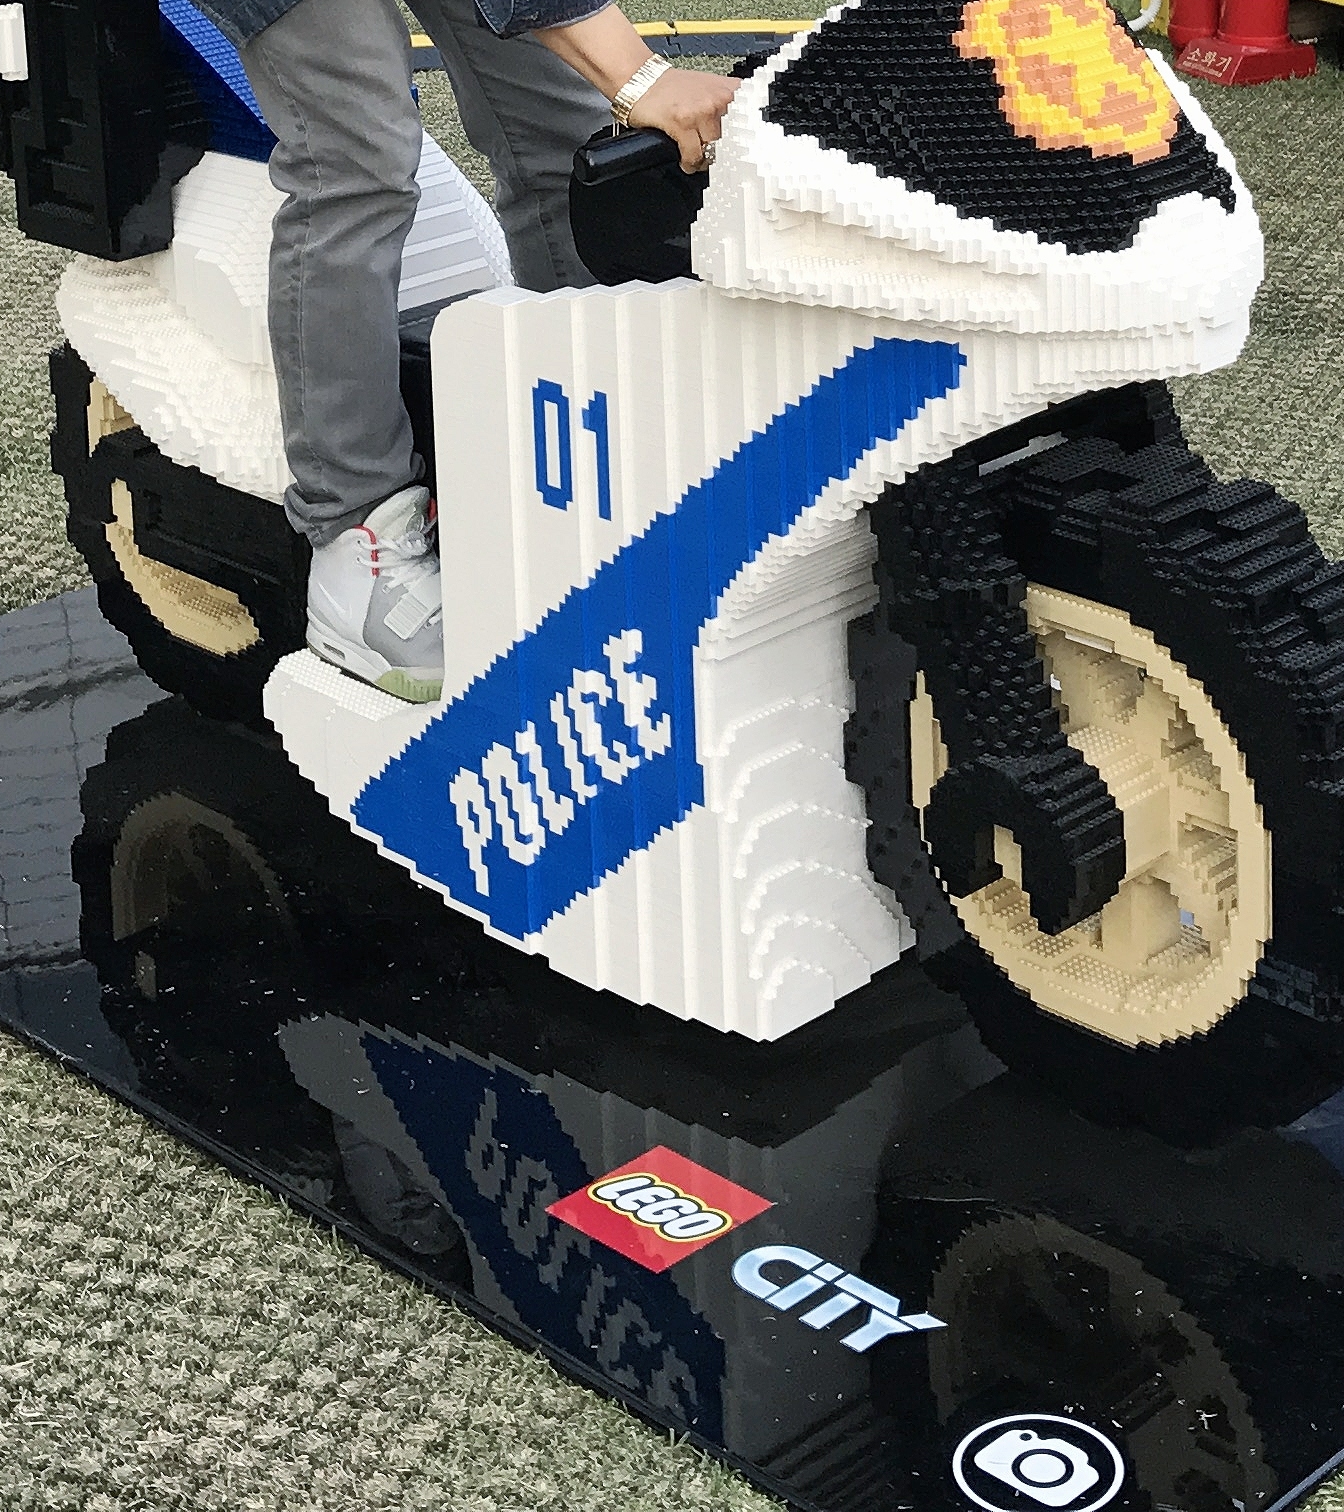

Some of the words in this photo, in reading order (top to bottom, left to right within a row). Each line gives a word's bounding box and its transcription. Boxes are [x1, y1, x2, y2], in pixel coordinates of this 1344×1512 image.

[1186, 47, 1233, 72] 소화기
[532, 377, 611, 521] 01
[449, 629, 672, 896] POLICE
[590, 1174, 730, 1241] LEGO
